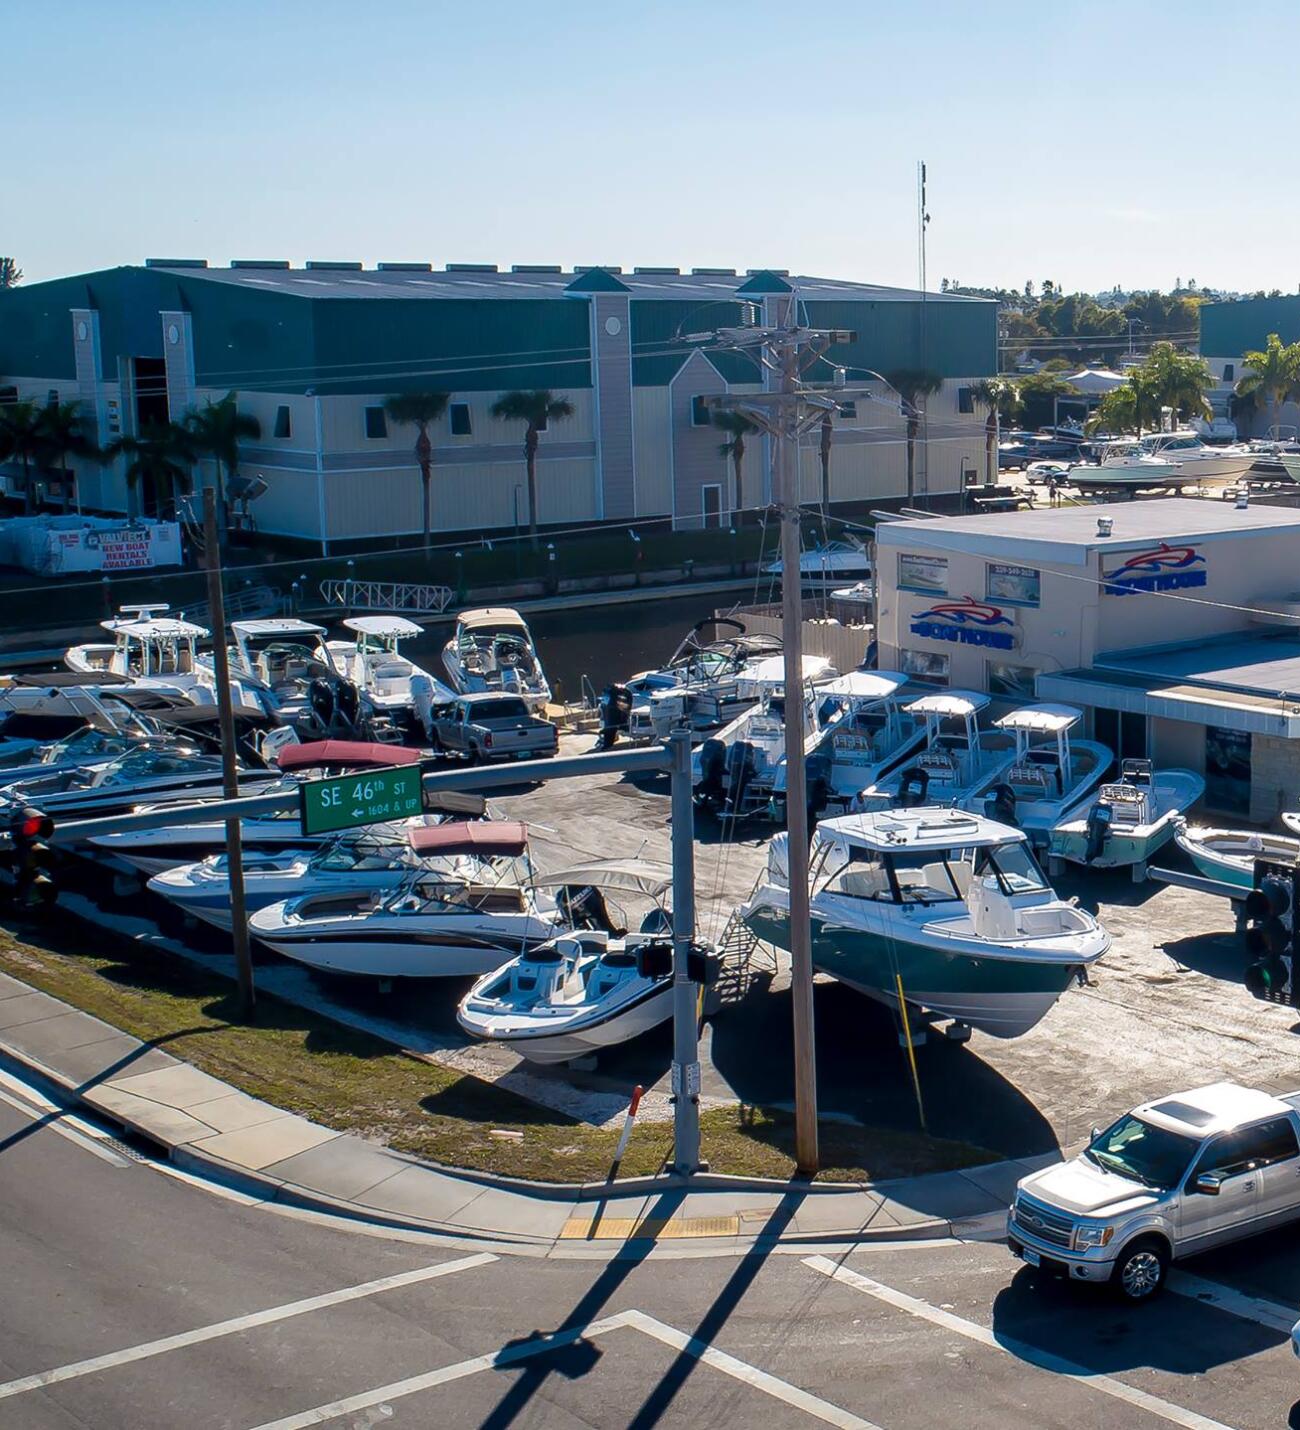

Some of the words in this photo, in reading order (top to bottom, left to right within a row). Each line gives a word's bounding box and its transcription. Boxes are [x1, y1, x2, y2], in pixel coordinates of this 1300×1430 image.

[103, 543, 124, 553] NEW
[126, 541, 150, 552] BOAT
[106, 551, 148, 561] RENTALS
[103, 558, 152, 569] AVAILABLE
[321, 786, 342, 807] SE
[352, 780, 385, 801] 46th
[394, 782, 406, 795] ST
[368, 803, 389, 816] 1604
[394, 801, 400, 812] &
[405, 799, 417, 810] UP
